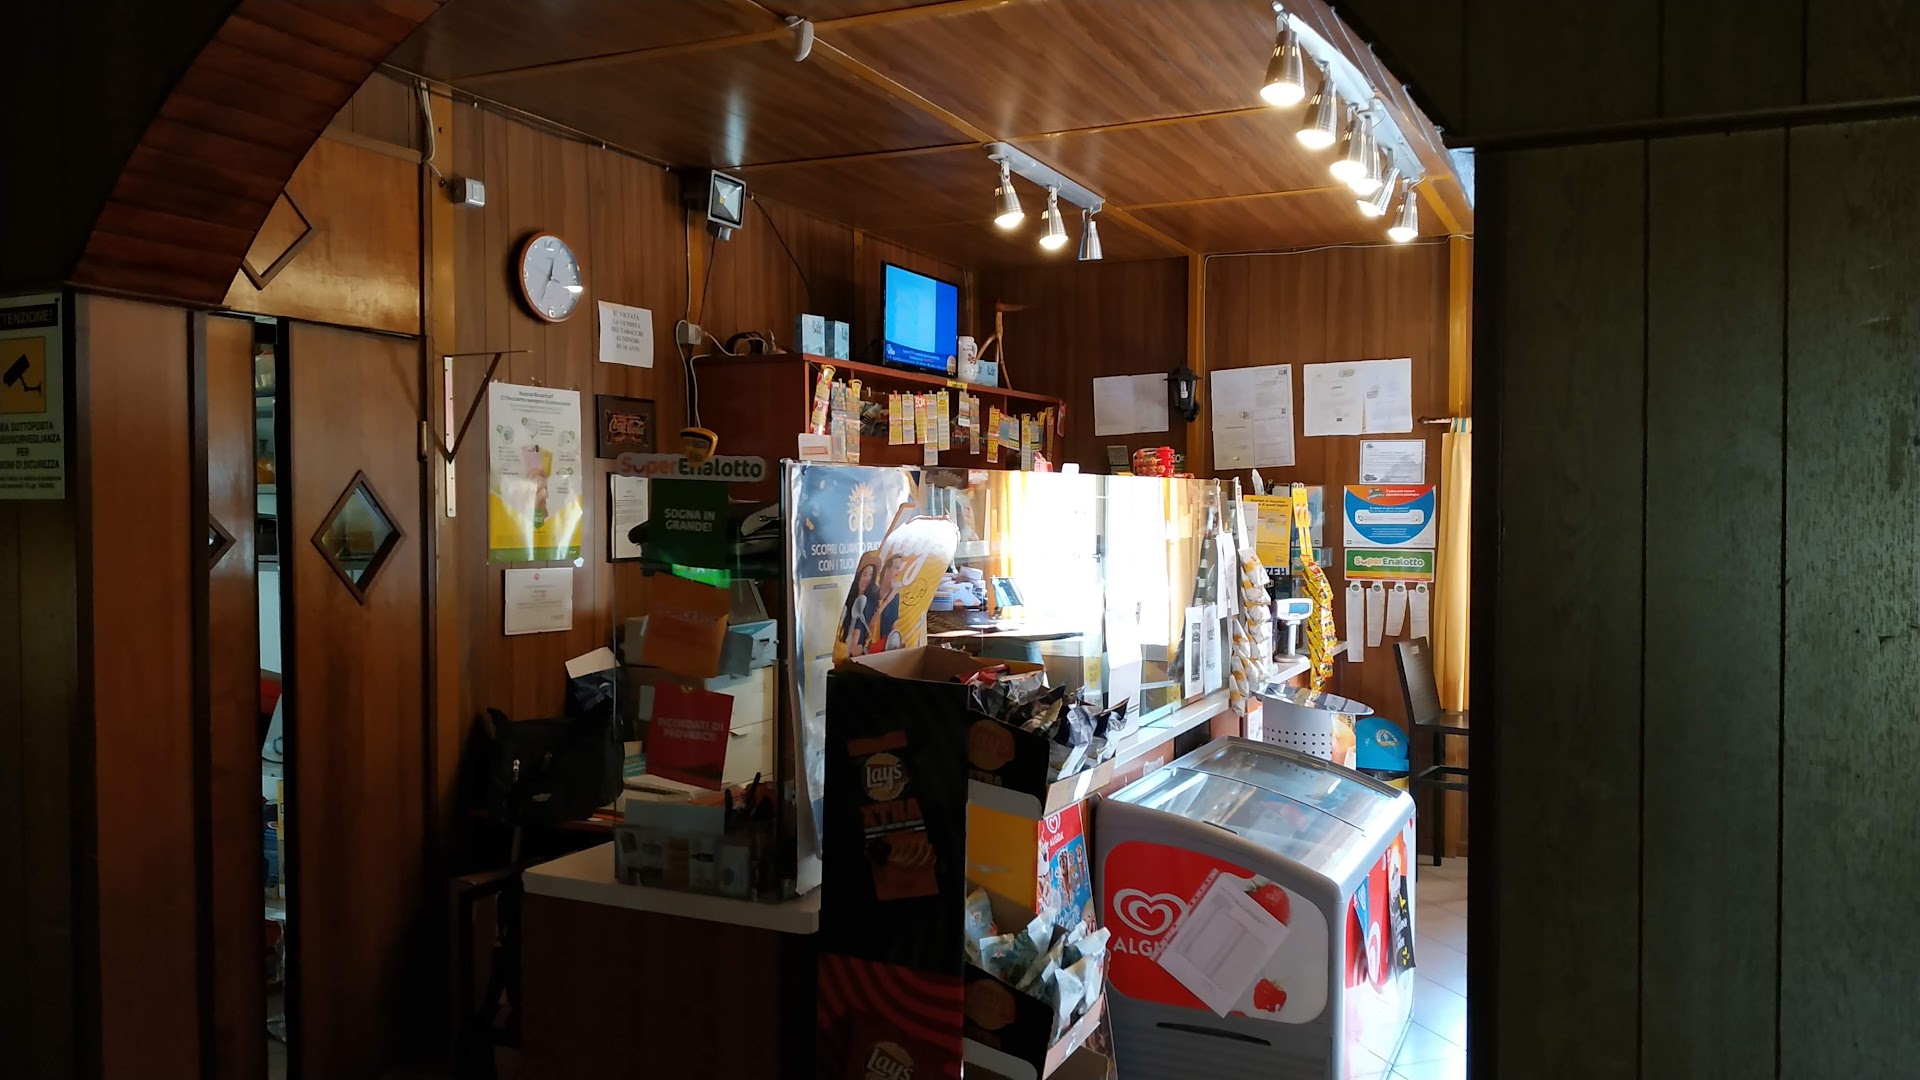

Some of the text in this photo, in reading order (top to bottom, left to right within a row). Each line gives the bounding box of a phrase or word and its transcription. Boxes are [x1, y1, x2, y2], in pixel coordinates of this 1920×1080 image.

[619, 311, 640, 321] VIETATA
[620, 319, 641, 328] VENDITA
[620, 327, 644, 336] TABACCHI
[622, 336, 640, 344] MINORI
[17, 447, 29, 457] PER
[24, 459, 60, 469] SICUREZZA
[664, 507, 716, 521] SOGNA IN
[665, 519, 713, 533] GRANDE!
[811, 543, 838, 556] SCOPRI
[818, 559, 835, 571] CON
[1355, 556, 1425, 567] SuperEnalotto
[858, 796, 925, 829] XTRA
